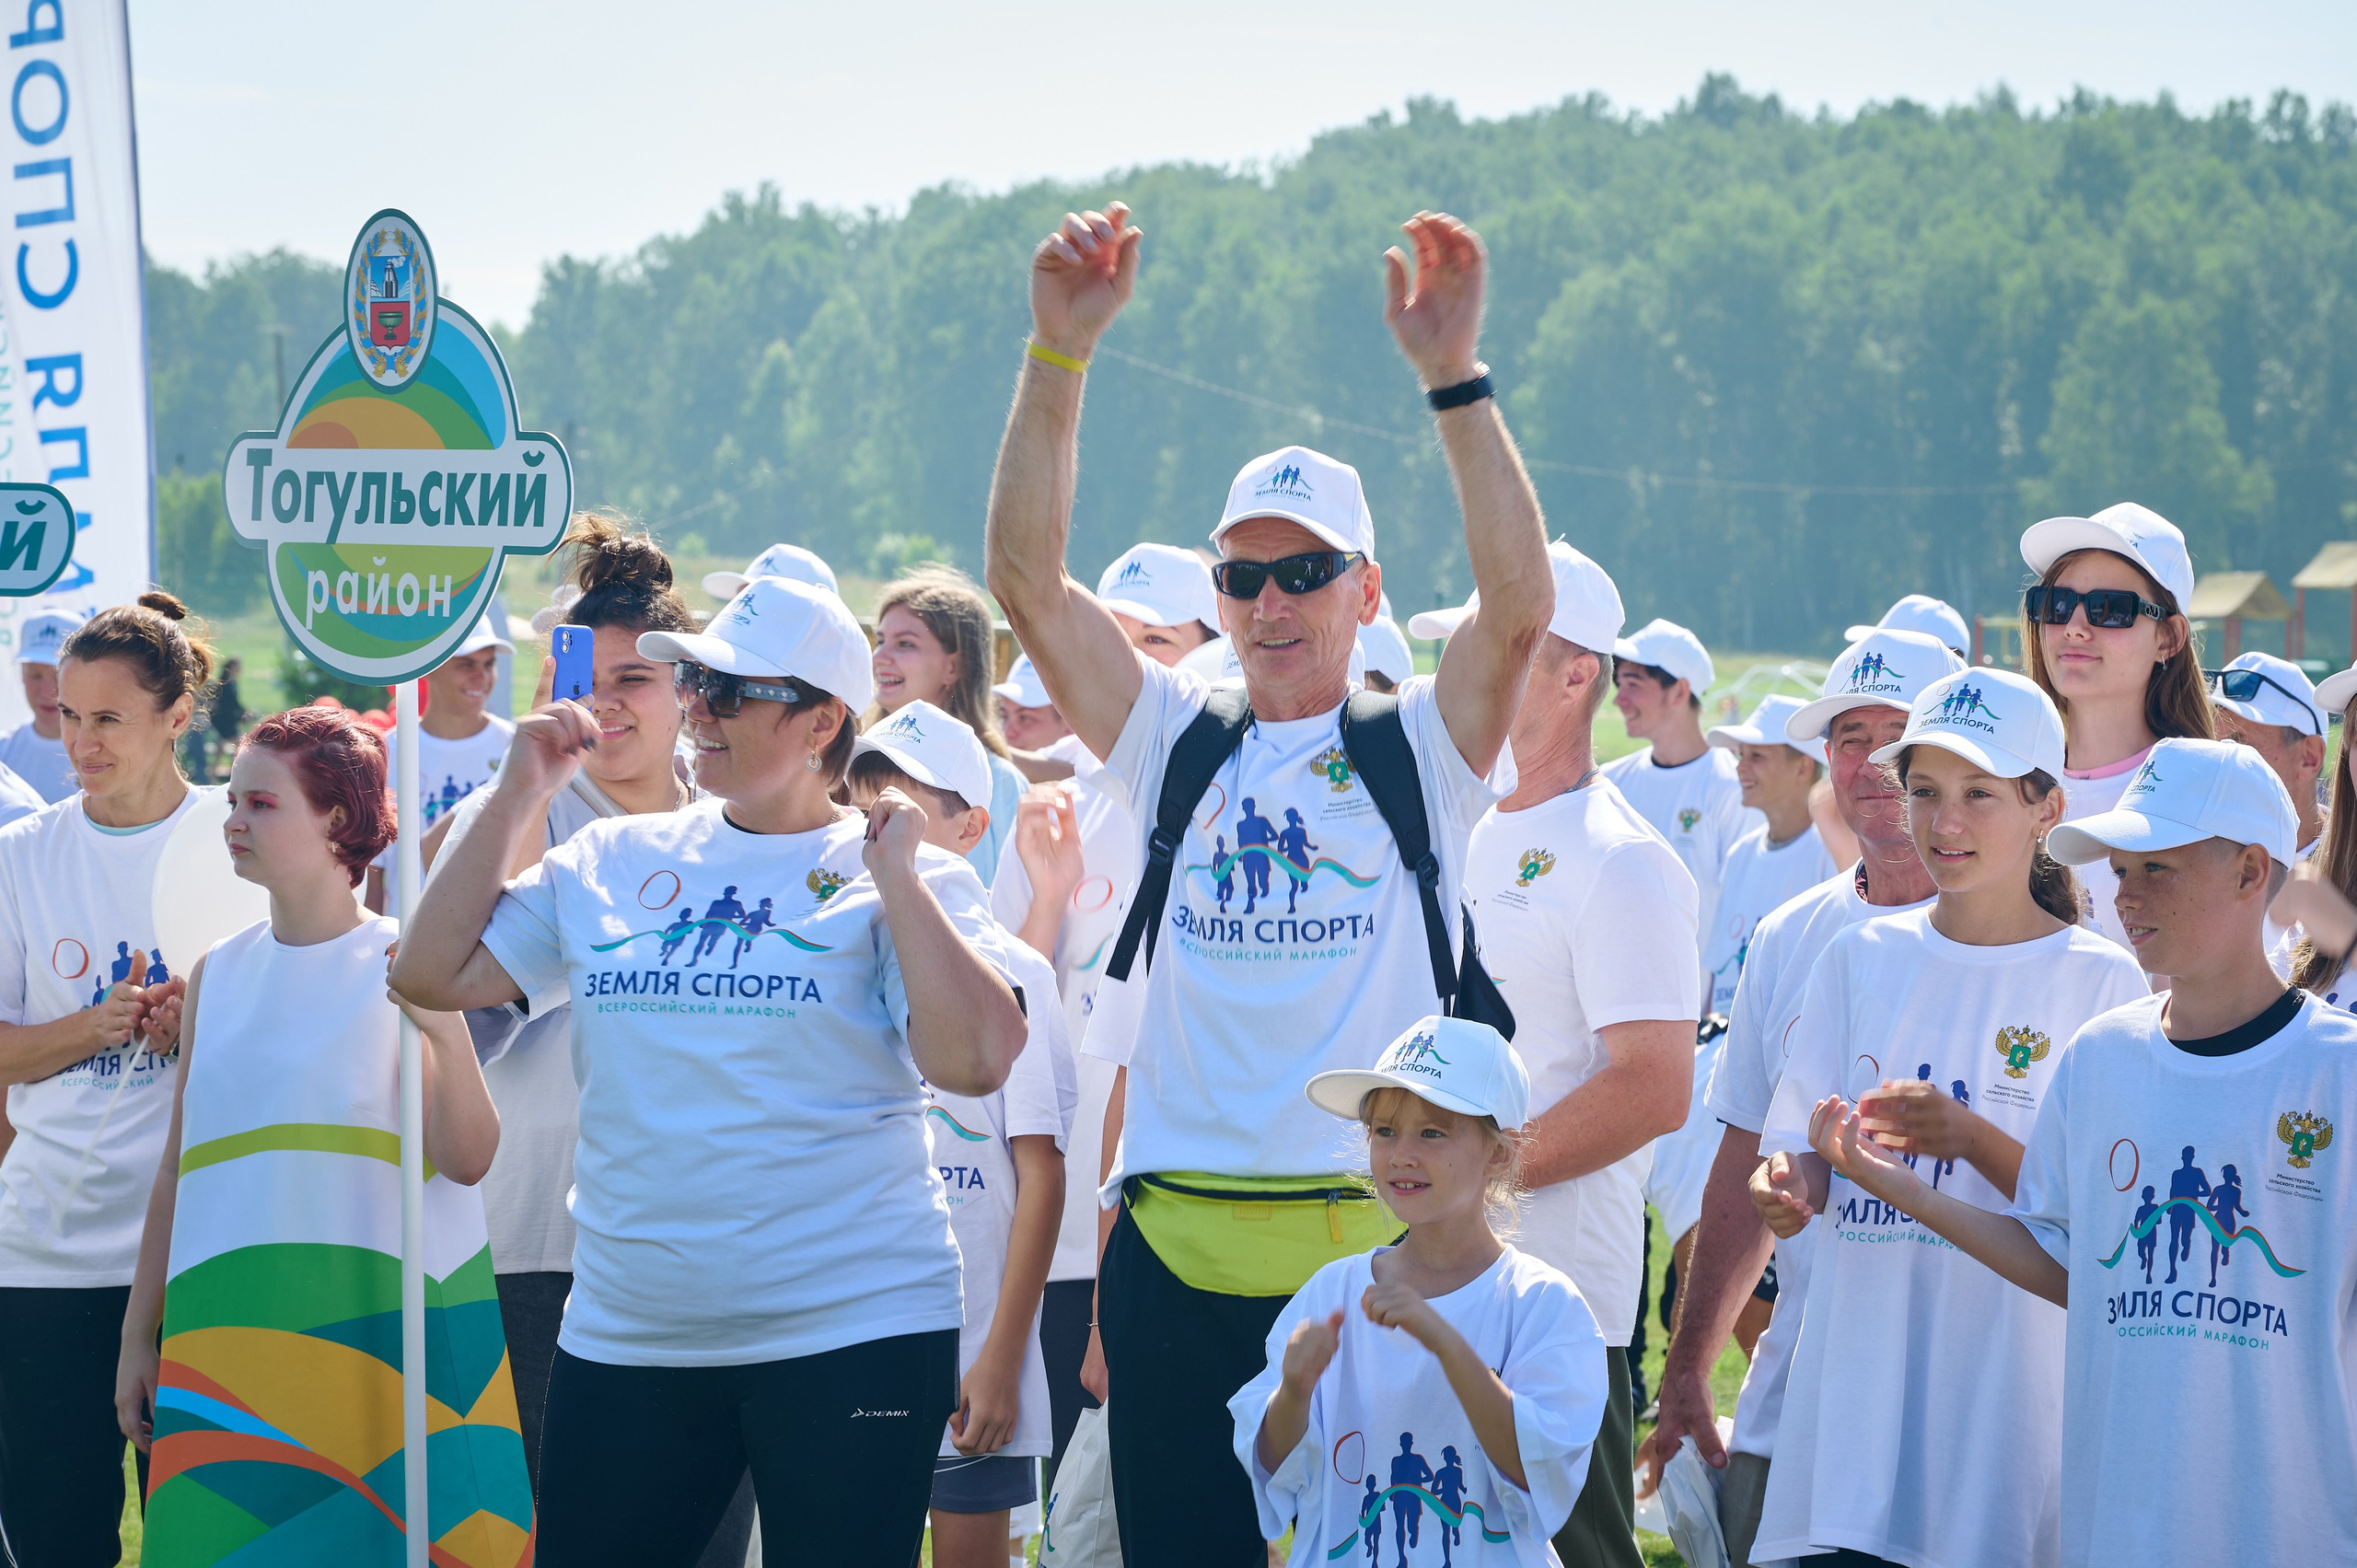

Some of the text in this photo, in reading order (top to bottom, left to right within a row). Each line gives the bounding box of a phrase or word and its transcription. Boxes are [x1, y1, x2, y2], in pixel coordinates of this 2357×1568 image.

[246, 447, 547, 545] Тогульский
[306, 556, 452, 630] район
[1861, 683, 1901, 693] СПОРТА
[1919, 716, 1994, 735] ЗЕМЛЯ СПОРТА
[1254, 913, 1374, 944] СПОРТА
[1289, 947, 1358, 961] МАРАФОН
[585, 970, 823, 1004] ЗЕМЛЯ СПОРТА
[598, 1001, 795, 1018] ВСЕРОССИЙСКИЙ МАРАФОН
[57, 1053, 121, 1076] ЕМЛЯ
[1399, 1063, 1442, 1079] СПОРТА
[1986, 1089, 2035, 1102] сельского хозяйства
[1993, 1084, 2030, 1095] Министерство
[1981, 1094, 2037, 1110] Российской Федерации
[2268, 1179, 2321, 1193] сельского хозяйства
[2276, 1173, 2315, 1185] Министерство
[2293, 1191, 2324, 1202] Федерации
[2171, 1290, 2288, 1337] СПОРТА
[2116, 1323, 2270, 1351] ОССИЙСКИЙ МАРАФОН
